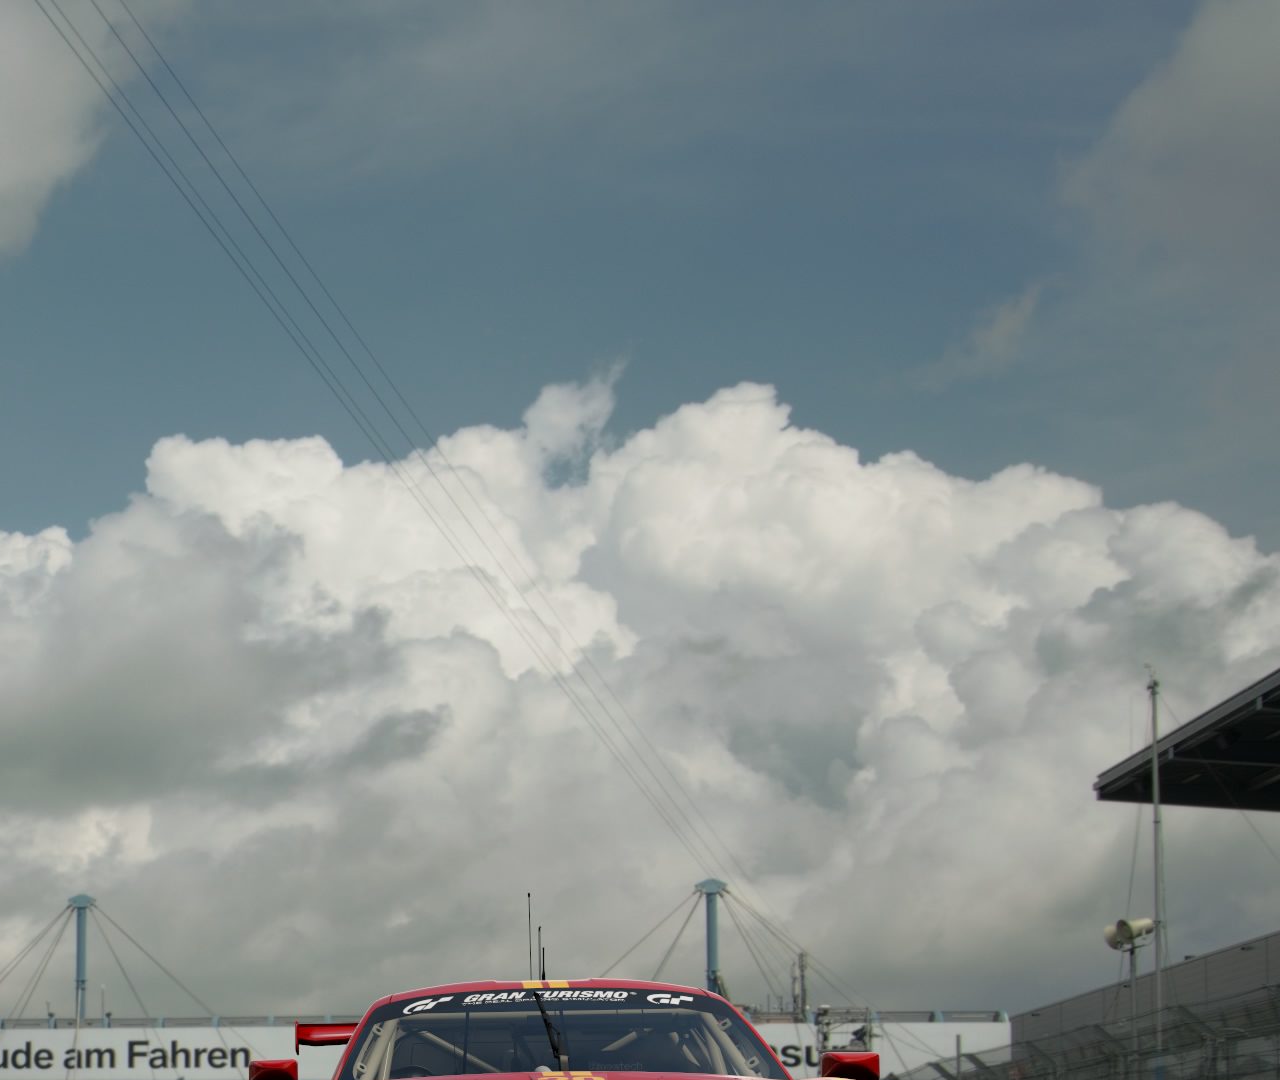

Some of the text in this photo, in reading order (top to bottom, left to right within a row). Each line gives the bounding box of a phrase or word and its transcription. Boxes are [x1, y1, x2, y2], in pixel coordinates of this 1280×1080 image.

[463, 990, 629, 1003] GRAN TURISMO
[63, 1045, 116, 1070] am
[127, 1040, 250, 1070] Fahren
